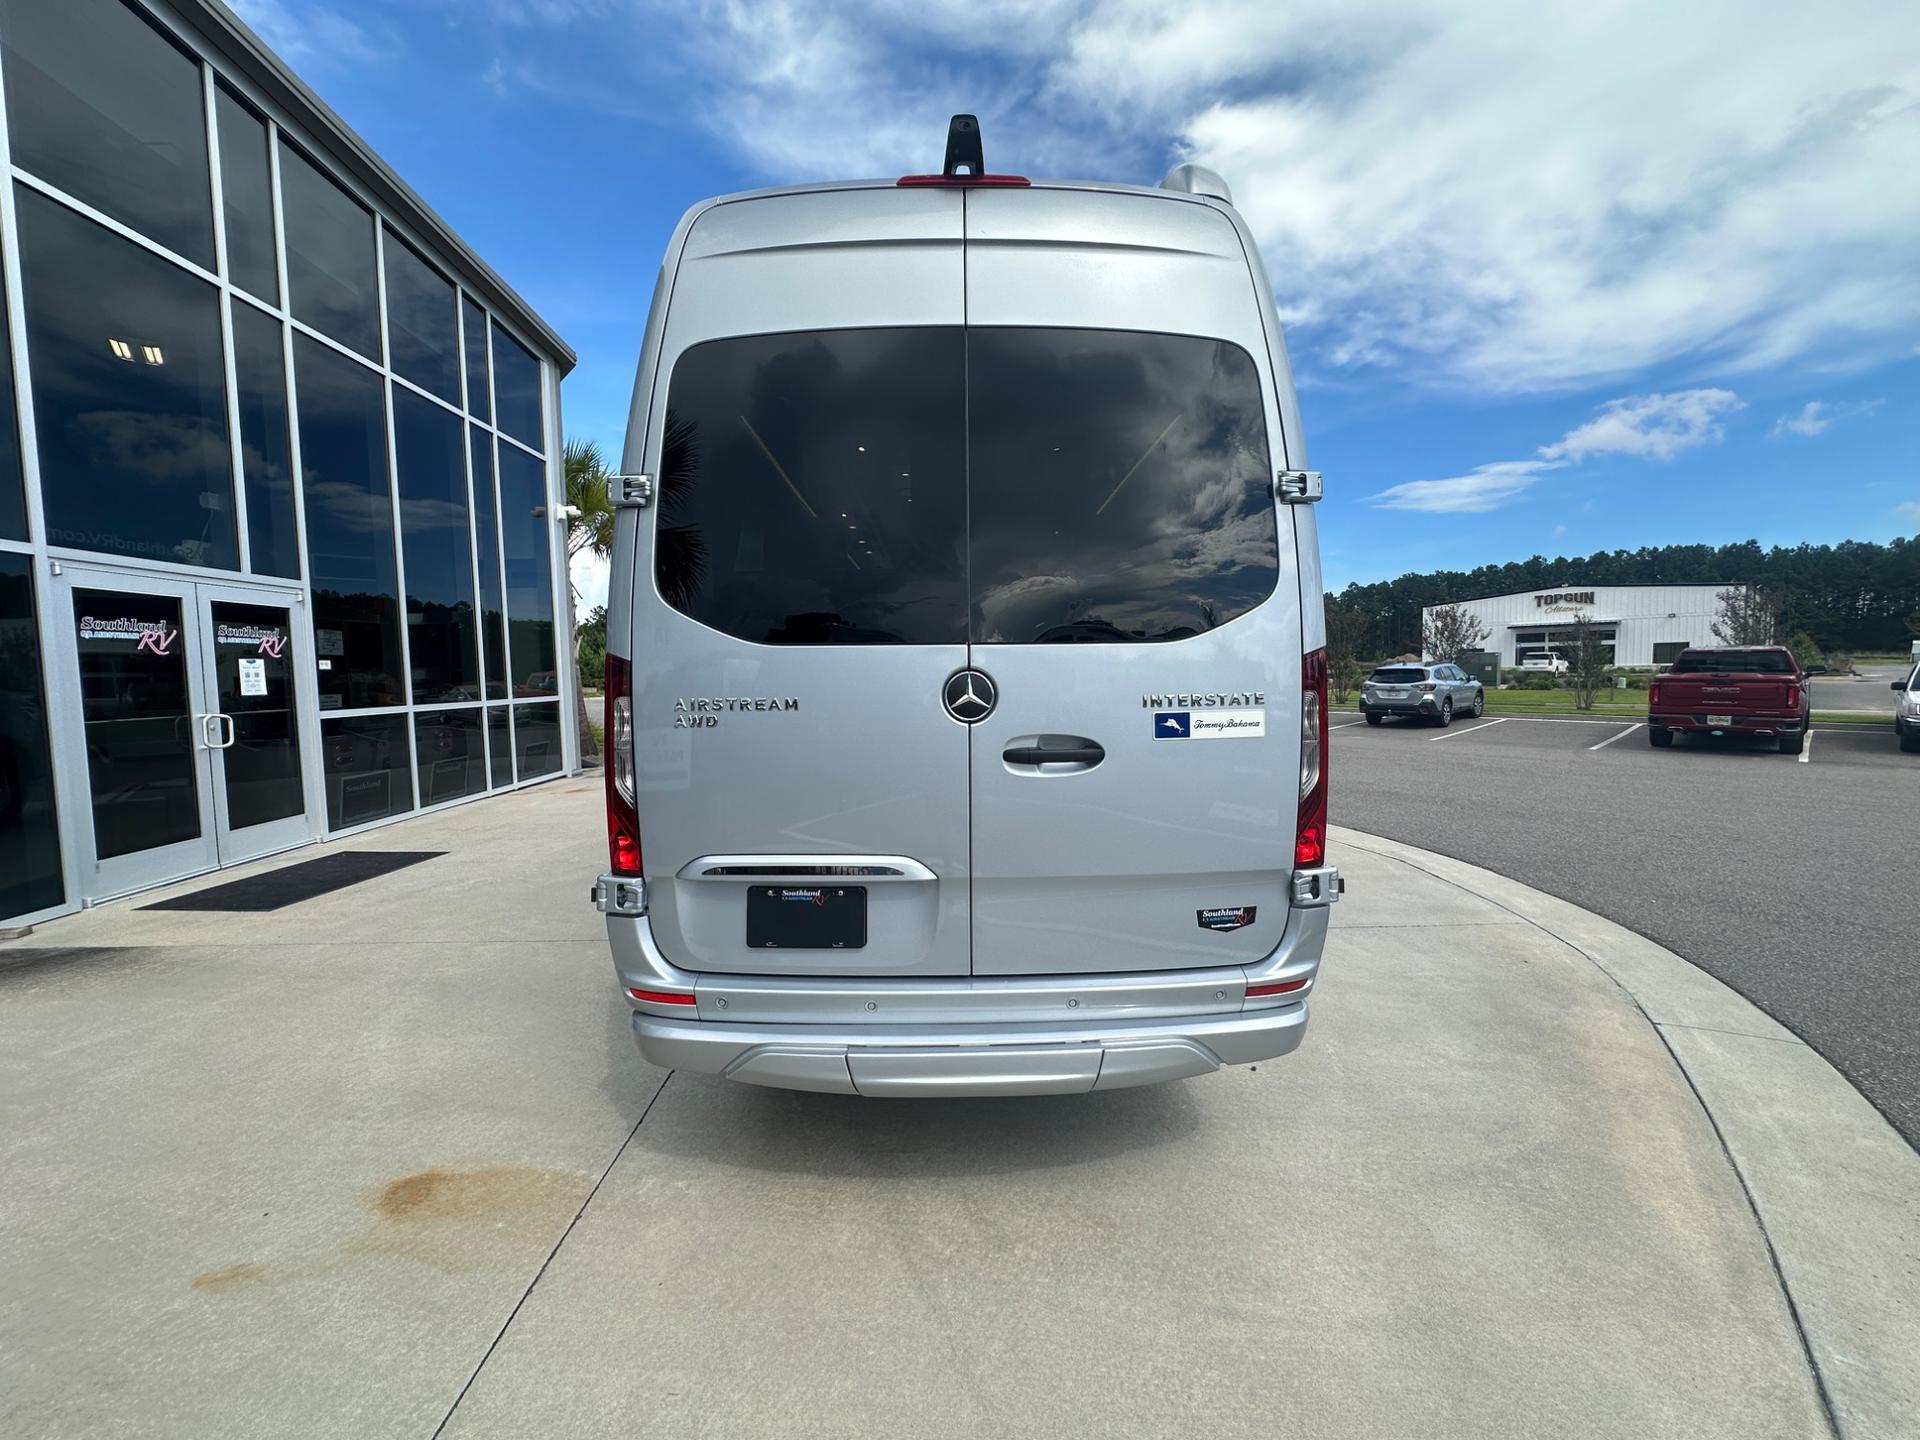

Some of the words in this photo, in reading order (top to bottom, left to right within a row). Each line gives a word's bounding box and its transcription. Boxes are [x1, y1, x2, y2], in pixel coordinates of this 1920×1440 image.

[1534, 591, 1595, 607] TOPGUN
[80, 616, 167, 632] Southland
[217, 624, 280, 638] Southland
[137, 629, 177, 655] RV
[258, 635, 287, 658] RV
[673, 696, 799, 712] AIRSTREAM
[1142, 691, 1265, 708] INTERSTATE
[673, 714, 719, 729] AWD
[782, 889, 821, 897] Southland
[1202, 907, 1244, 918] Southland
